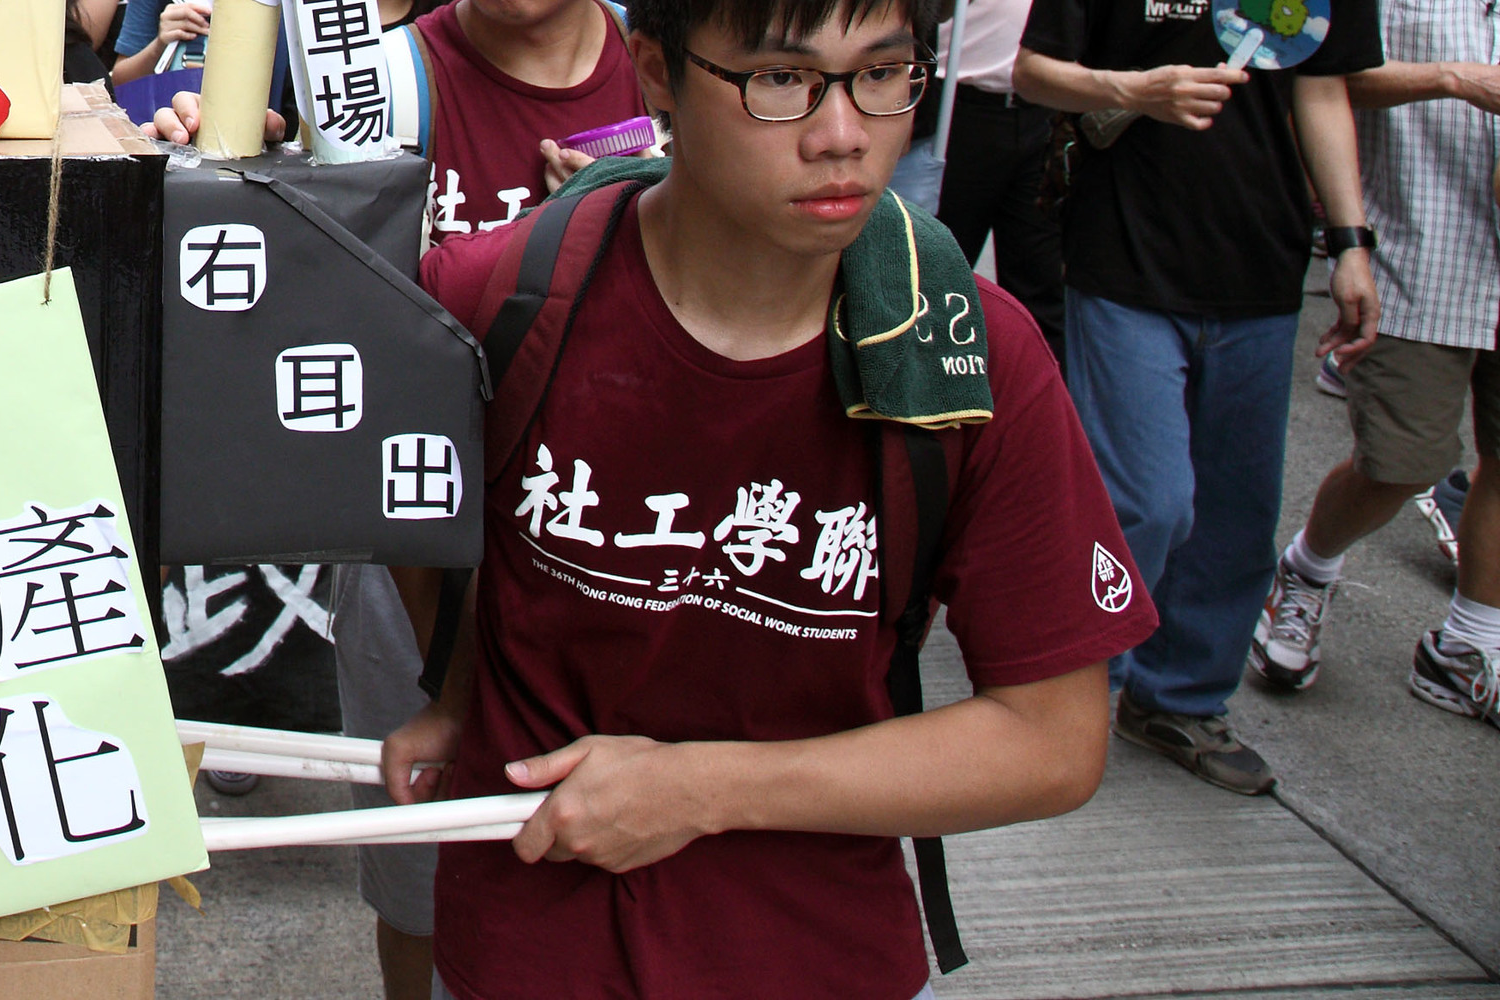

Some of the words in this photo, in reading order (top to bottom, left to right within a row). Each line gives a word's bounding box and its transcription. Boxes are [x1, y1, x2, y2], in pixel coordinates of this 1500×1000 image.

[515, 443, 879, 600] 社工學聯
[532, 558, 550, 574] THE
[550, 568, 576, 586] 36TH
[576, 580, 607, 602] HONG
[608, 592, 642, 610] KONG
[703, 597, 722, 612] OF
[721, 602, 762, 625] SOCIAL
[764, 615, 801, 637] WORK
[801, 625, 857, 640] STUDENTS
[657, 566, 730, 592] 三十六
